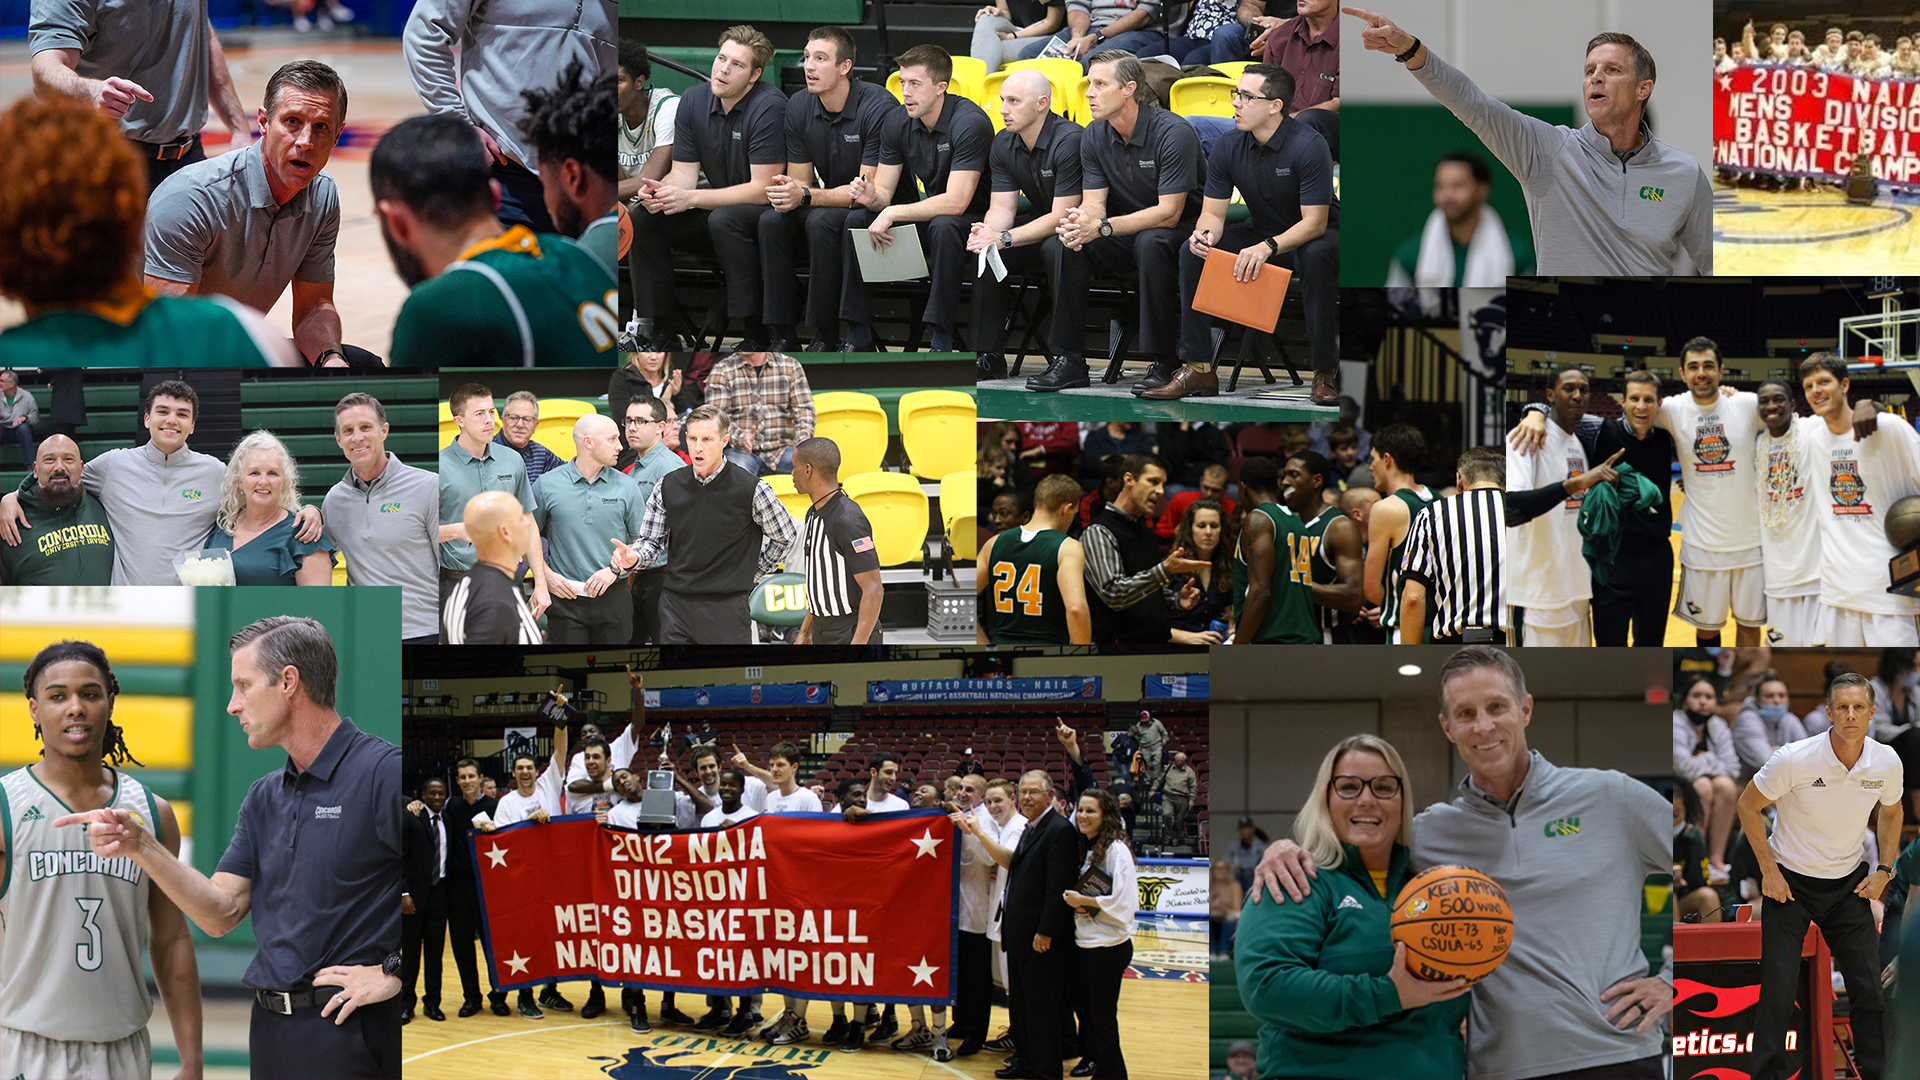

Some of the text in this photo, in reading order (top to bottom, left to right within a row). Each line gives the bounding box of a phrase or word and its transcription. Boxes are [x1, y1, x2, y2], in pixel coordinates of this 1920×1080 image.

[1752, 68, 1920, 107] 2003 NAIA
[1729, 92, 1792, 119] MENS
[1718, 140, 1920, 182] NATIONAL CAMP
[1698, 426, 1723, 438] NAIA
[1832, 462, 1857, 474] NAIA
[37, 524, 111, 553] CONCORDIA
[1287, 532, 1312, 586] 14
[764, 583, 809, 612] CU
[993, 560, 1042, 616] 24
[423, 680, 438, 690] 113
[747, 667, 761, 678] 111
[902, 680, 1069, 692] BUFFALO FUNDS NAIA
[948, 691, 989, 700] BASKETBALL
[989, 691, 1021, 700] NATIONAL
[1022, 691, 1076, 700] CHAMPIONSHIP
[21, 813, 45, 823] adidas
[611, 826, 767, 865] 2012 NAIA
[29, 849, 144, 887] CONCORDIA
[1170, 866, 1190, 875] OX
[613, 866, 767, 901] DIVISION I
[1427, 880, 1460, 901] KEN
[1440, 897, 1504, 916] 500 WINS
[75, 897, 104, 972] 3
[554, 903, 869, 944] ME'S BASKETBALL
[1431, 922, 1479, 938] CUI-73
[1421, 936, 1484, 952] CSULA-63
[696, 947, 875, 986] CHAMPION
[651, 1034, 831, 1063] BUFFALO
